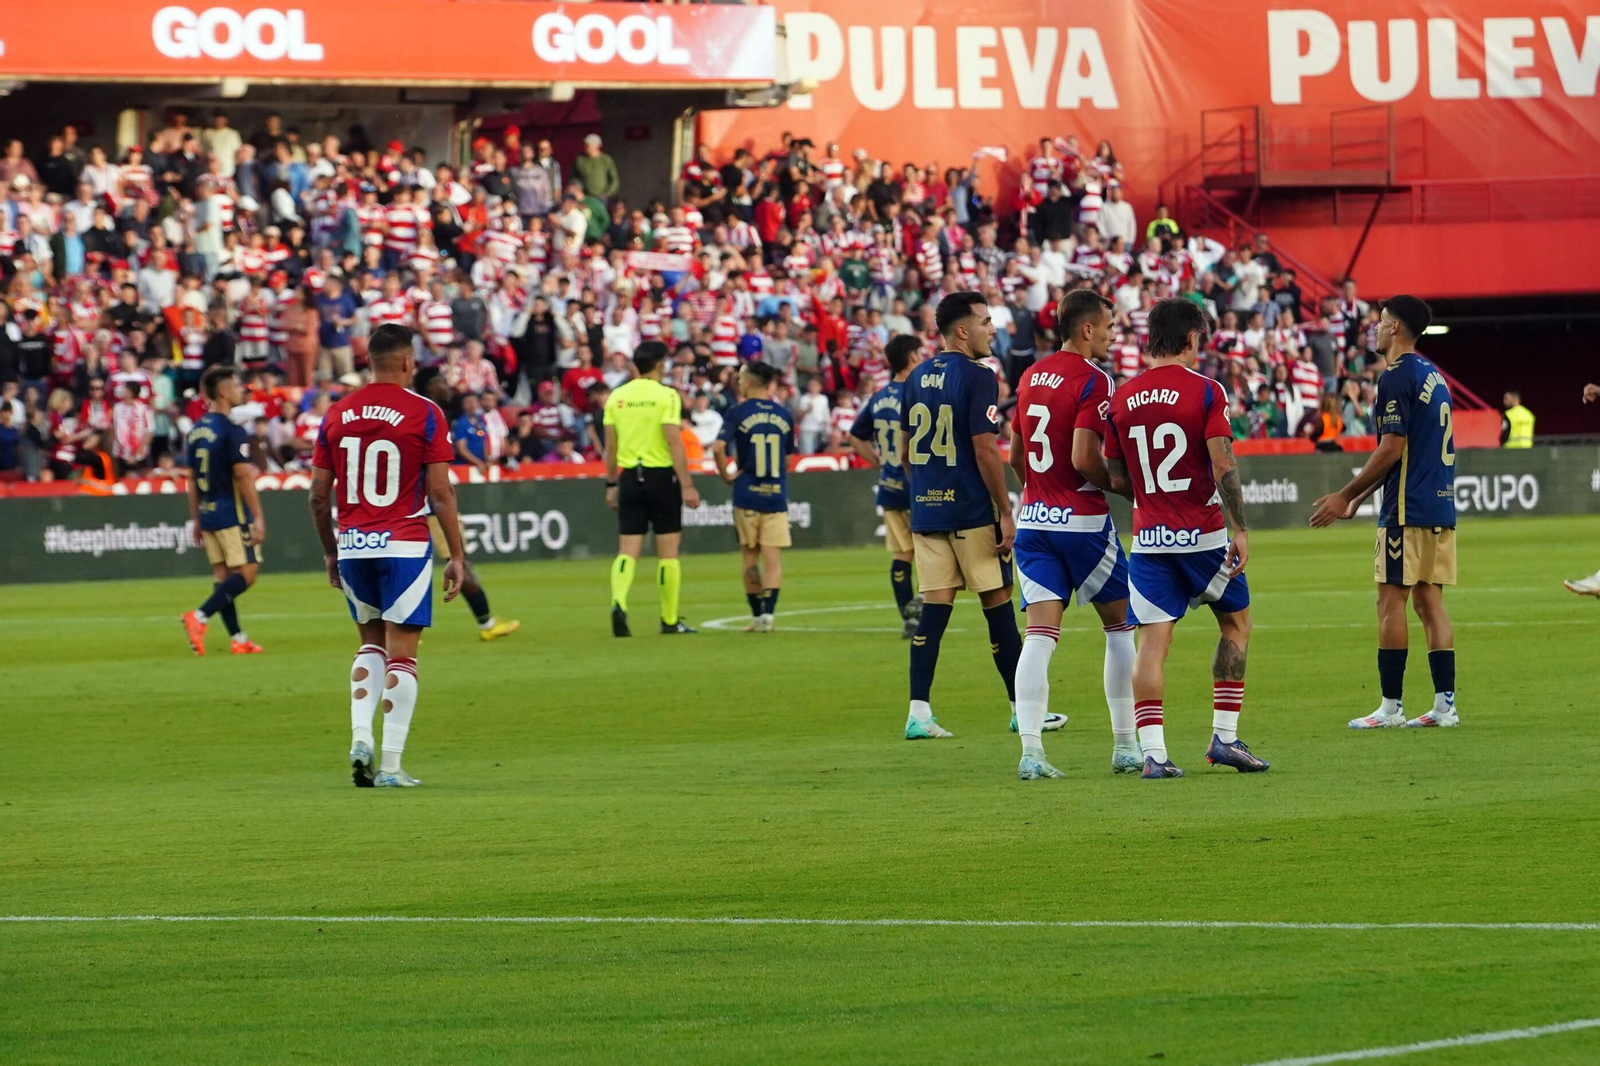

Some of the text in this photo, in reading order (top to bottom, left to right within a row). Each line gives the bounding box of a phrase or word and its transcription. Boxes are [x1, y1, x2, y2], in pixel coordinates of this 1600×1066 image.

[152, 7, 324, 61] GOOL
[532, 13, 690, 65] GOOL
[785, 11, 1119, 110] PULEVA
[1030, 372, 1064, 389] BRAU
[1127, 389, 1179, 411] RICARD
[342, 406, 405, 427] M. UZUNI
[909, 403, 956, 466] 24
[1026, 404, 1054, 473] 3
[750, 433, 780, 478] 11
[874, 419, 902, 467] 33
[1128, 422, 1192, 494] 12
[339, 436, 401, 507] 10
[1020, 503, 1073, 524] wiber
[1139, 526, 1200, 547] wiber
[339, 530, 391, 549] wiber
